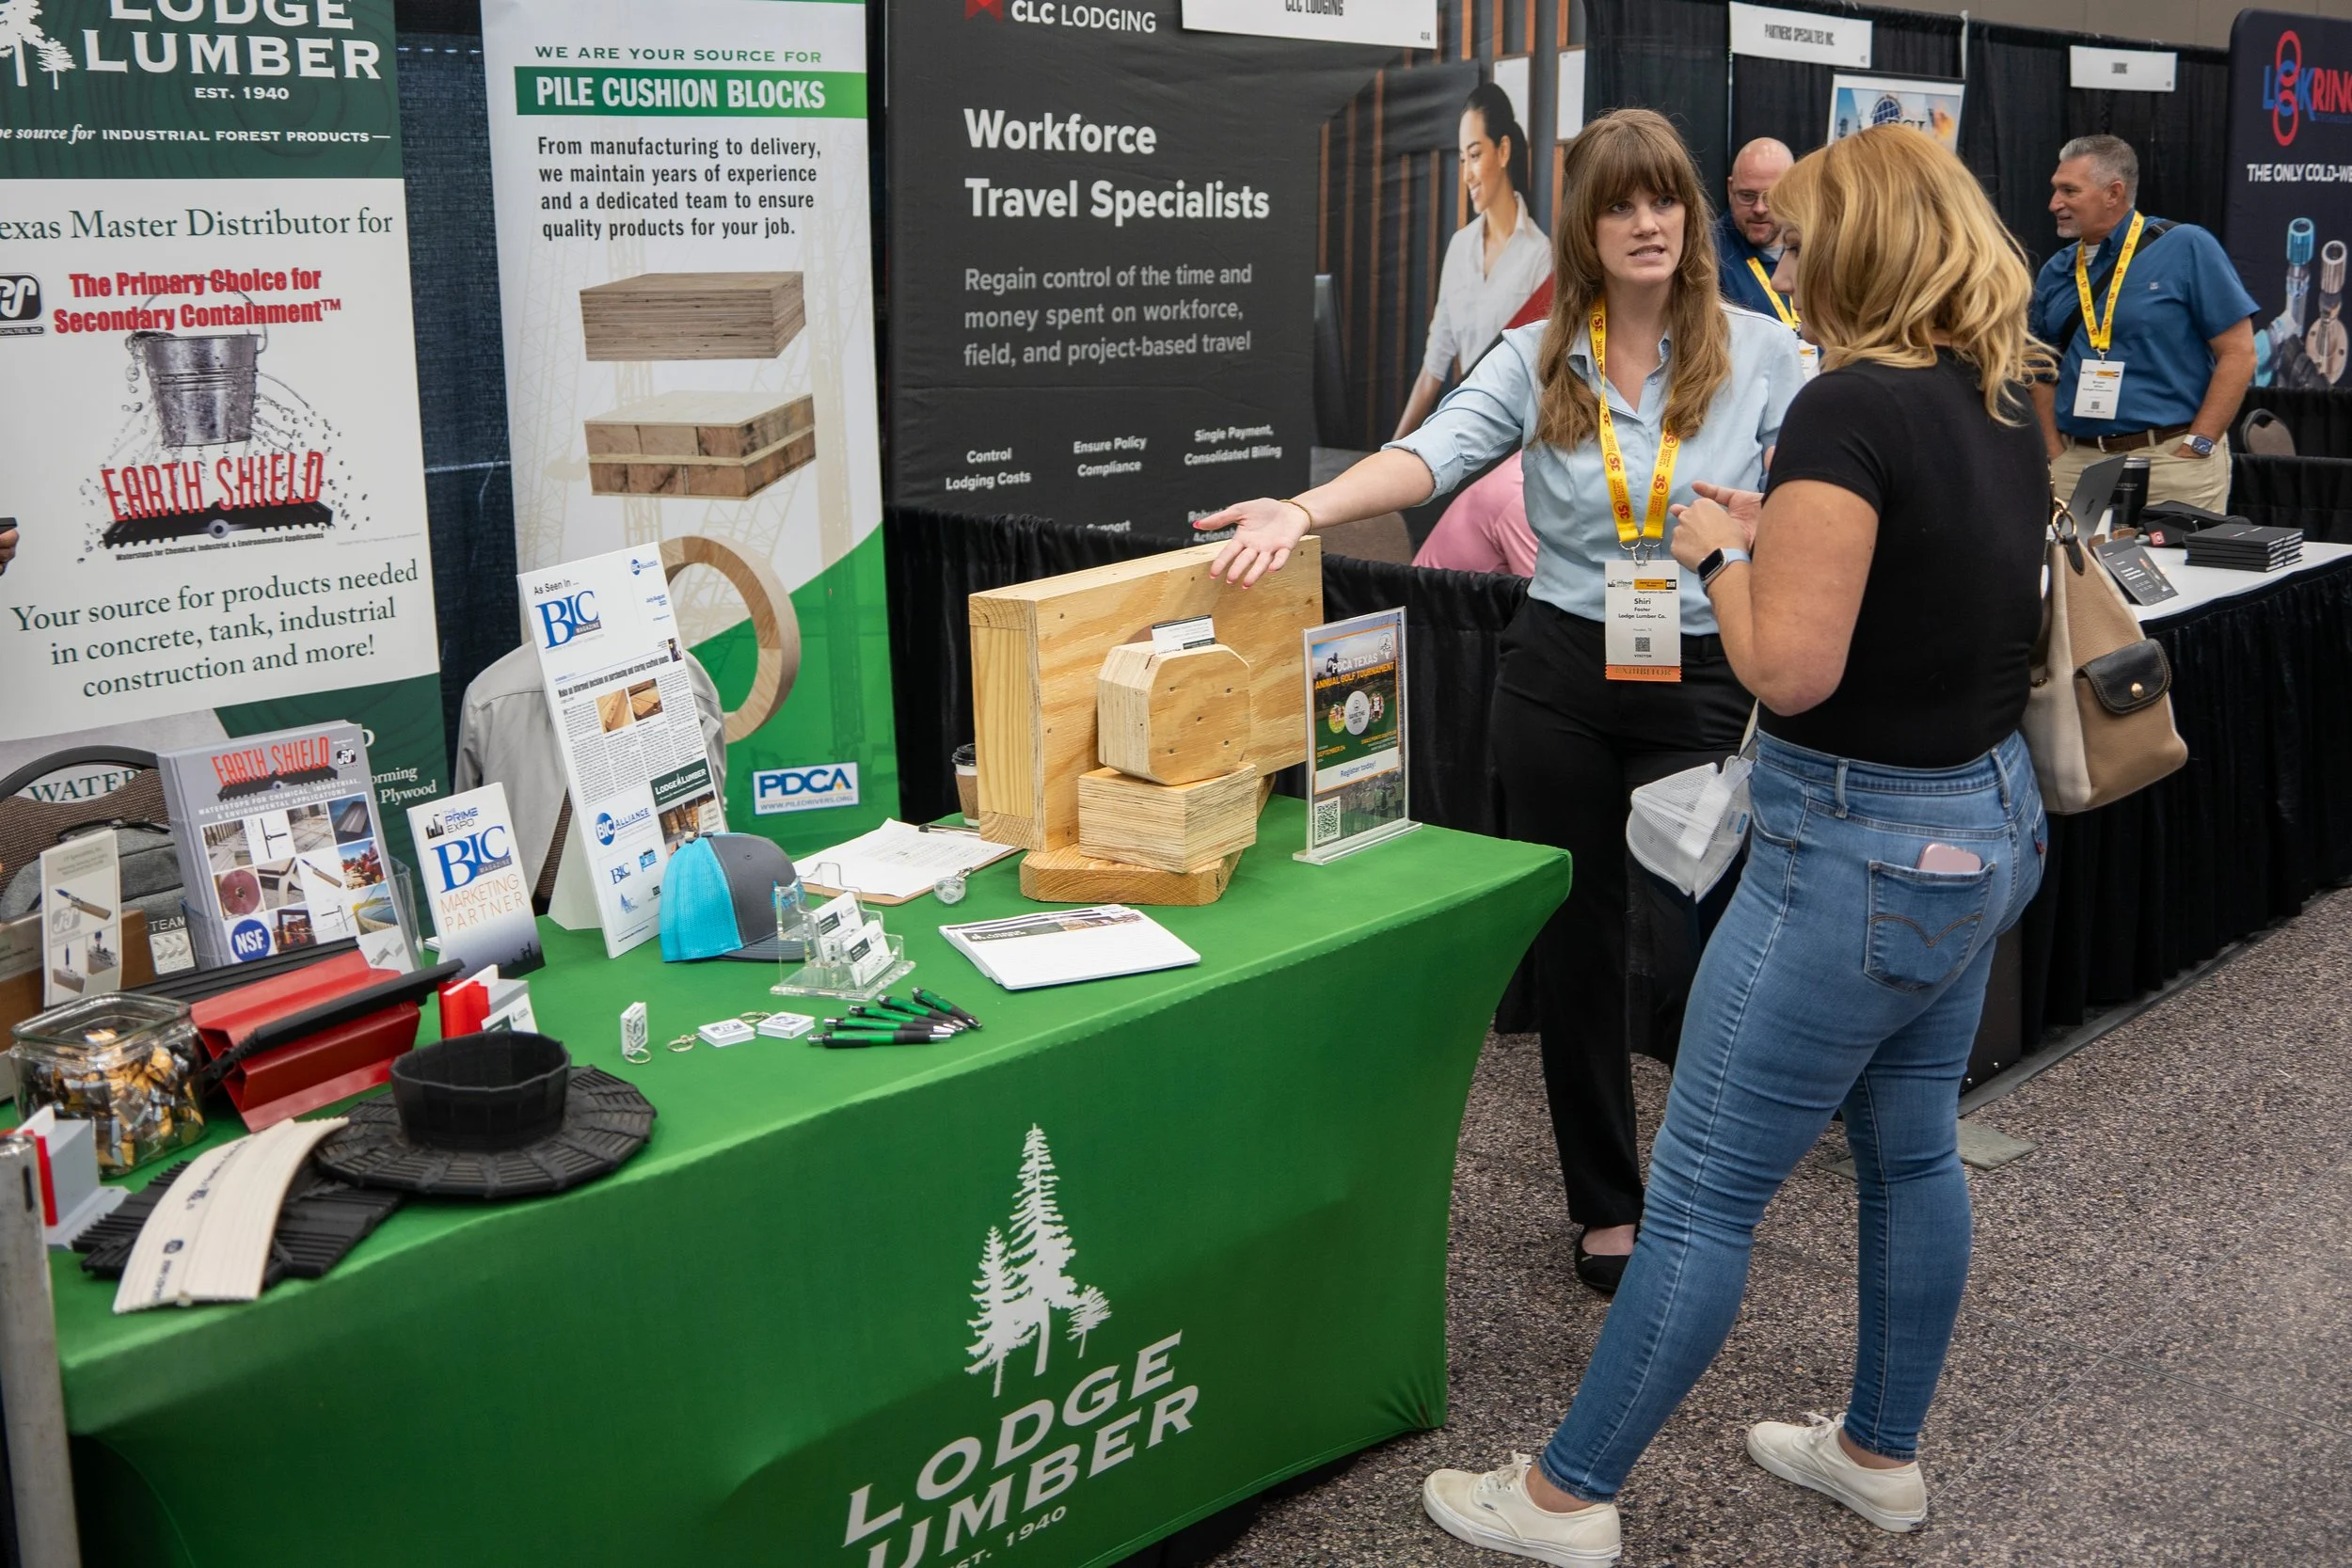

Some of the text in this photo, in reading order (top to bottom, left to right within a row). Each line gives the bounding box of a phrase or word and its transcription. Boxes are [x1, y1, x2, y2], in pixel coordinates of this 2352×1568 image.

[1010, 0, 1156, 33] CLC LODGING
[82, 29, 381, 79] LUMBER
[534, 46, 821, 64] WE ARE YOUR SOURCE FOR
[195, 87, 290, 101] EST. 1940
[536, 76, 825, 109] PILE CUSHION BLOCKS
[16, 126, 68, 140] source
[69, 123, 95, 145] for
[103, 130, 210, 141] INDUSTRIAL
[215, 131, 280, 142] FOREST
[286, 132, 370, 143] PRODUCTS
[963, 108, 1156, 154] Workforce
[537, 136, 821, 160] From manufacturing to delivery,
[539, 164, 818, 186] we maintain years of experience
[2247, 164, 2273, 182] THE
[2273, 164, 2305, 183] ONLY
[541, 191, 814, 210] and a dedicated team to ensure
[965, 178, 1269, 228] Travel Specialists
[0, 207, 393, 240] exas Master Distributor for
[543, 216, 795, 241] quality products for your job.
[69, 267, 322, 297] The Primary Choice for
[964, 263, 1252, 295] Regain control of the time and
[54, 306, 175, 334] Secondary
[964, 299, 1244, 331] money spent on workforce,
[963, 331, 1251, 367] field, and project-based travel
[1073, 436, 1147, 454] Ensure Policy
[1194, 424, 1274, 444] Single Payment,
[966, 448, 1011, 465] Control
[1077, 460, 1141, 479] Compliance
[1184, 443, 1282, 466] Consolidated Billing
[102, 451, 324, 521] EARTH SHIELD
[946, 470, 1031, 491] Lodging Costs
[10, 559, 419, 632] Your source for products needed
[534, 579, 571, 595] As Seen In
[51, 596, 396, 665] in concrete, tank, industrial
[535, 590, 598, 649] BIC
[83, 634, 375, 697] construction and more!
[1332, 653, 1378, 673] PDCA TEXAS
[1614, 667, 1671, 676] EXHIBITOR
[1315, 676, 1340, 689] ANNUAL
[1341, 672, 1355, 684] GOLF
[211, 748, 269, 786] EARTH
[271, 736, 329, 775] SHIELD
[380, 779, 437, 805] Plywood
[759, 768, 852, 798] PDCA
[199, 800, 250, 816] WATERSTOPS
[252, 796, 267, 804] FOR
[225, 801, 290, 819] ENVIRONMENTAL
[292, 788, 346, 804] APPLICATIONS
[445, 807, 479, 825] PRIME
[448, 818, 474, 833] EXPO
[596, 820, 614, 840] BIC
[615, 808, 649, 828] ALLIANCE
[431, 825, 510, 894] BIC
[440, 873, 518, 915] MARKETING
[445, 892, 525, 933] PARTNER
[234, 933, 263, 956] NSF
[842, 1329, 1183, 1547] LODGE
[867, 1385, 1199, 1568] UMBER
[1006, 1506, 1067, 1547] 1940
